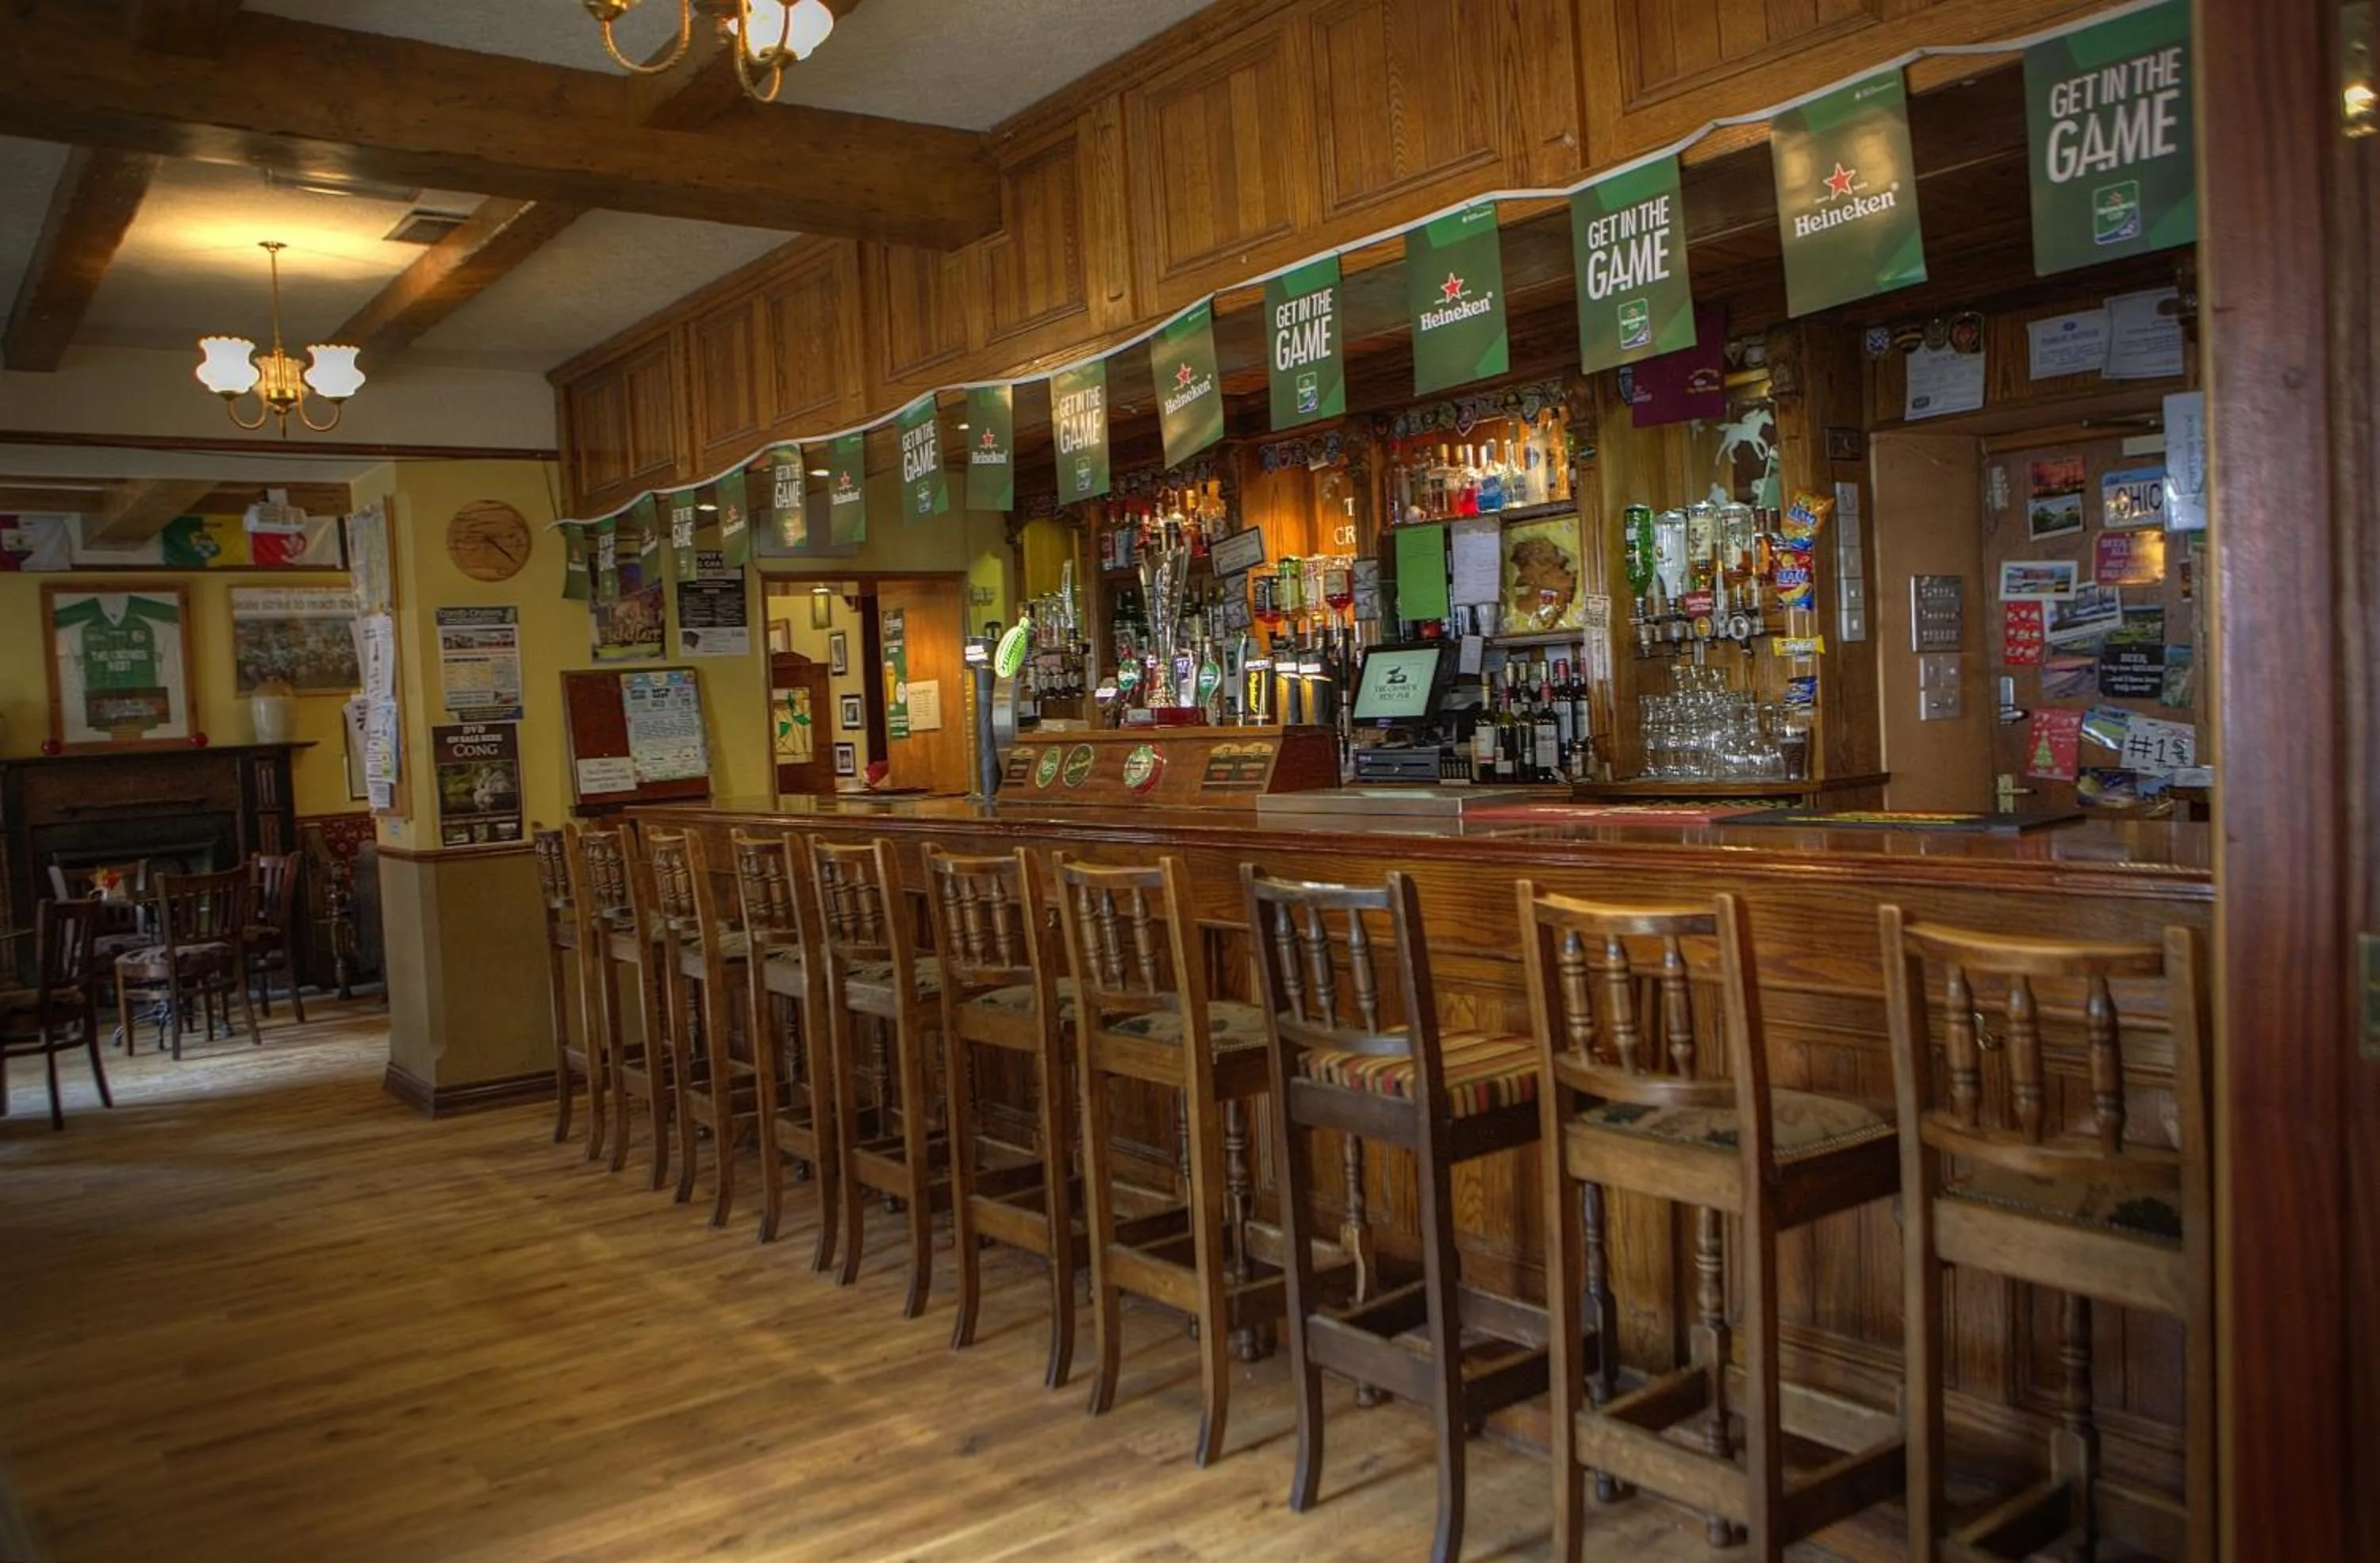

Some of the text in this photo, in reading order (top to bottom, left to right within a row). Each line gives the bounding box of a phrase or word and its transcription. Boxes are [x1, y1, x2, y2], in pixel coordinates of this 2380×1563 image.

[2050, 47, 2183, 118] GET IN THE
[2046, 88, 2180, 183] GAME
[1587, 194, 1670, 250] GET IN THE
[1794, 190, 1896, 238] Heineken
[1587, 227, 1670, 301] GAME
[1276, 287, 1334, 329] GET IN THE
[1420, 298, 1491, 331] Heineken
[1276, 314, 1333, 371] GAME
[1059, 395, 1075, 418] GET
[1085, 385, 1101, 409] THE
[1165, 380, 1212, 415] Heineken
[1059, 407, 1101, 454] GAME
[904, 439, 937, 483] GAME
[452, 743, 498, 757] CONG
[463, 725, 486, 734] DVD
